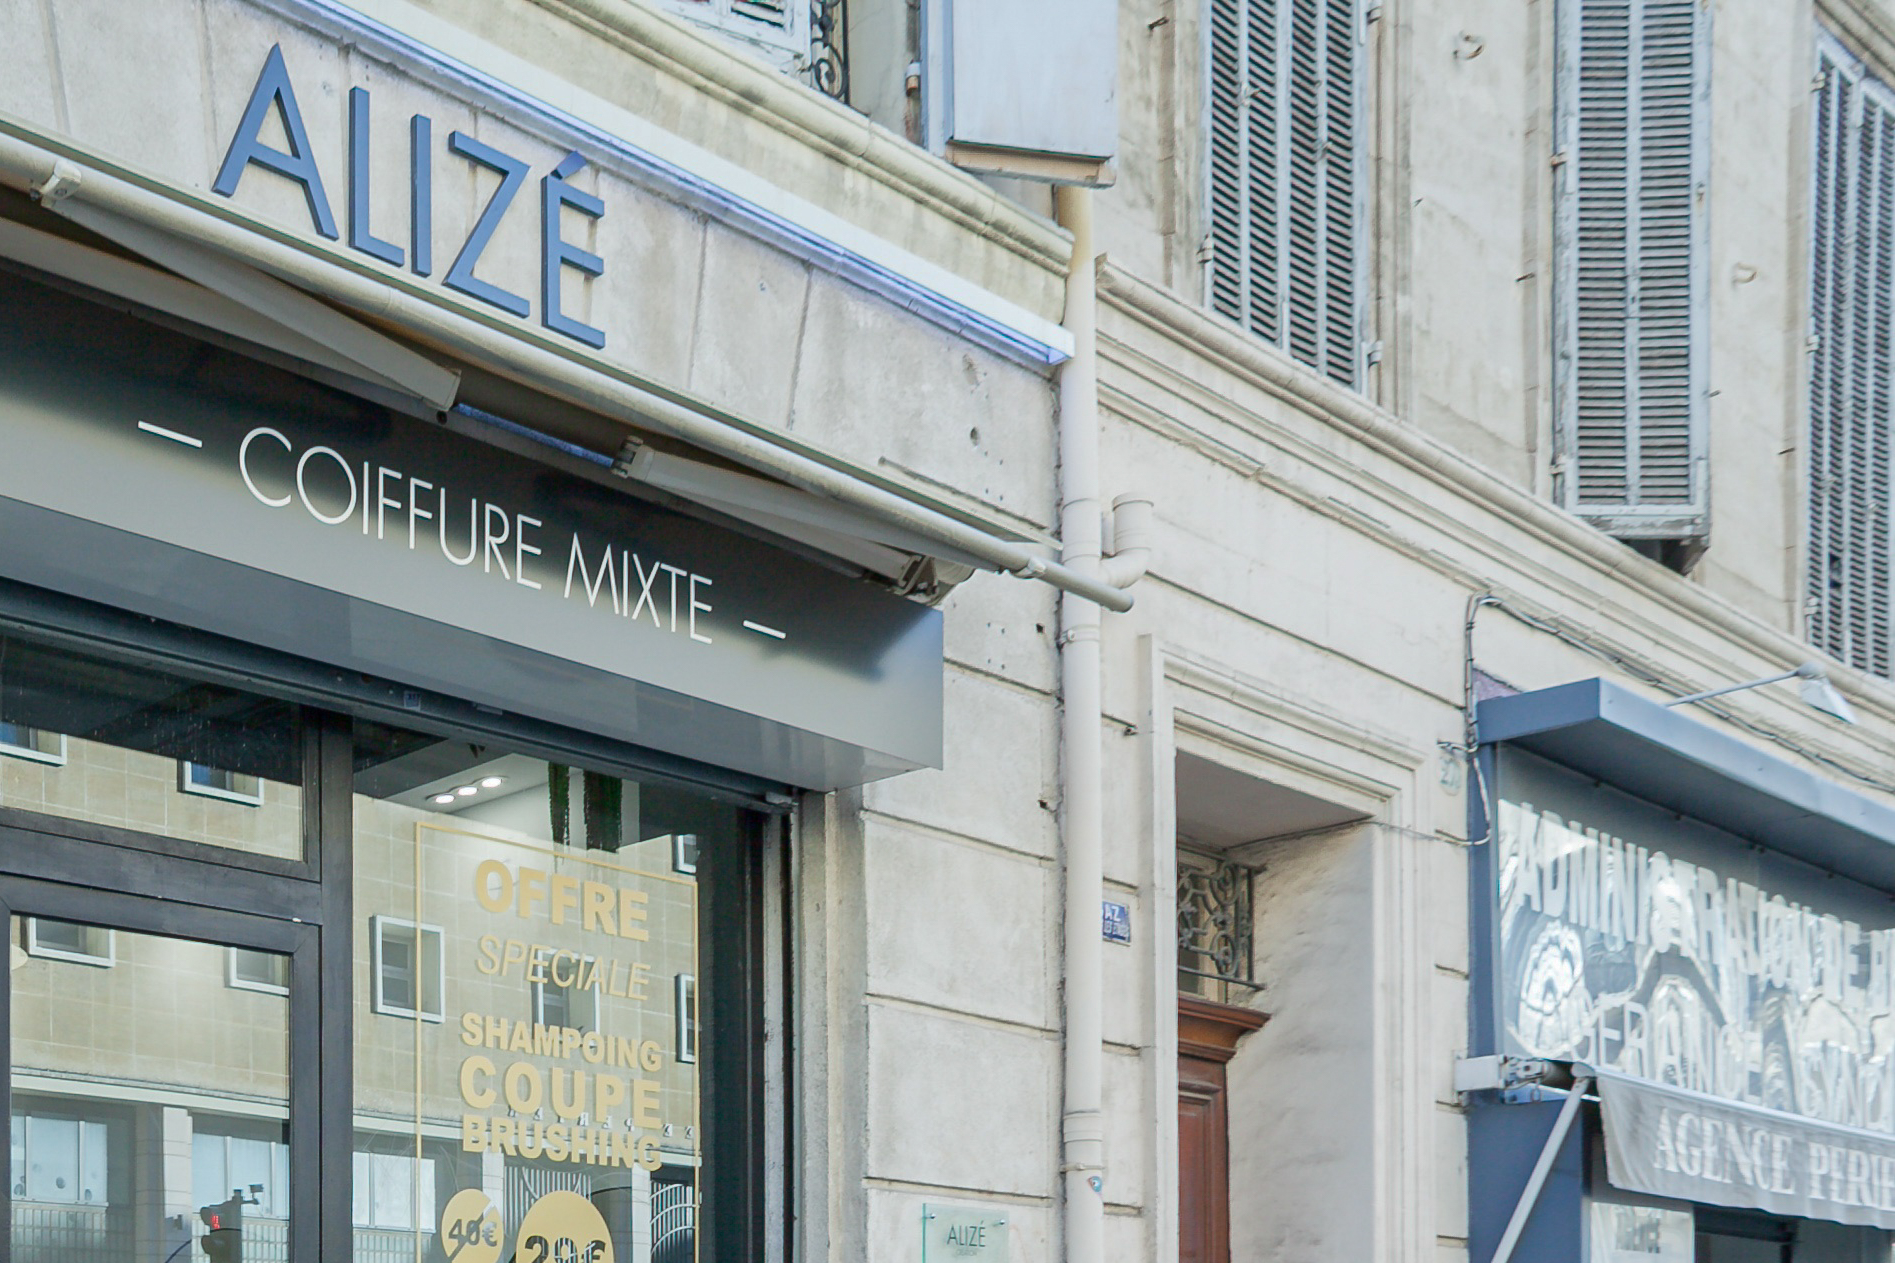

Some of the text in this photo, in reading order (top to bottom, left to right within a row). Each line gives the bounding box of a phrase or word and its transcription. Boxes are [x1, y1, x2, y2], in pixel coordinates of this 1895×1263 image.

[211, 42, 606, 350] ALIZÉ
[239, 426, 713, 644] COIFFURE MIXTE
[475, 859, 650, 942] OFFRE
[475, 934, 652, 1001] SPECIALE
[461, 1011, 662, 1073] SHAMPOING
[460, 1054, 662, 1130] COUPE
[462, 1114, 663, 1172] BRUSHING
[1654, 1107, 1796, 1195] AGENCE
[448, 1217, 499, 1248] 40€
[946, 1220, 986, 1247] ALIZÉ
